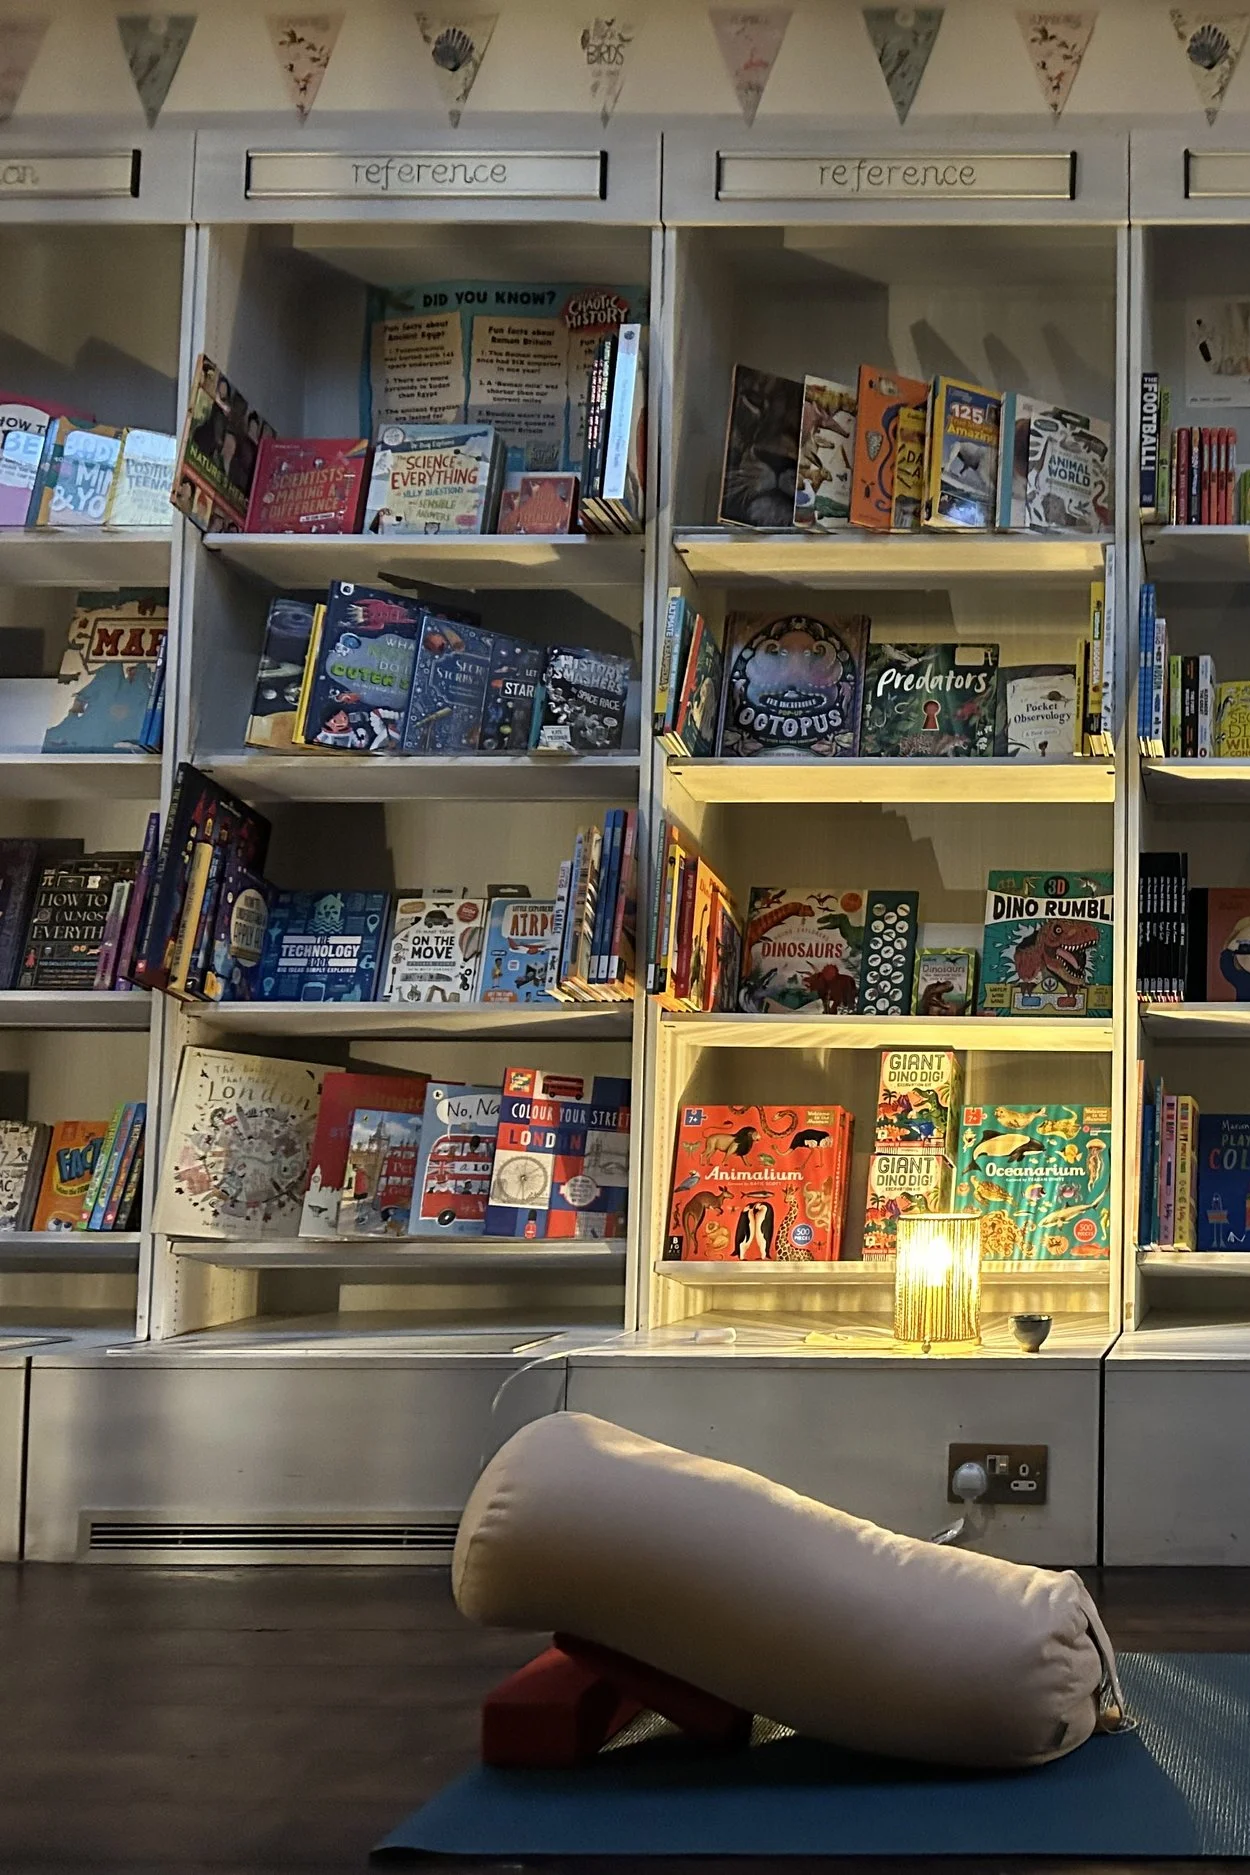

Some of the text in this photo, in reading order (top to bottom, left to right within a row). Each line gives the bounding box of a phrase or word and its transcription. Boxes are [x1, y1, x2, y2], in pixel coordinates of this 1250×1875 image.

[352, 158, 507, 190] reference
[818, 160, 977, 193] reference
[423, 290, 556, 307] DID YOU KNOW?
[567, 295, 617, 316] CHAOTIC
[564, 308, 628, 327] HISTORY
[951, 403, 983, 425] 125
[406, 453, 457, 471] SCIENCE
[1048, 454, 1092, 476] ANIMAL
[271, 465, 345, 490] SCIENTISTS
[391, 467, 479, 490] EVERYTHING
[1047, 465, 1092, 488] WORLD
[277, 485, 324, 503] MAKING
[260, 497, 341, 519] DIFFERENCE
[561, 654, 629, 675] HISTORY
[331, 664, 394, 688] OUTER
[553, 667, 623, 694] SMASHERS
[876, 663, 988, 698] Predators
[578, 689, 621, 711] SPACE RACE
[1025, 702, 1058, 712] Pocket
[740, 707, 843, 738] OCTOPUS
[1013, 710, 1072, 725] Observology
[1048, 880, 1067, 894] 3D
[40, 893, 108, 907] HOW TO
[993, 894, 1039, 920] DINO
[32, 925, 104, 940] EVERYTH
[509, 914, 555, 937] AIRP
[412, 935, 455, 946] ON THE
[281, 944, 360, 958] TECHNOLOGY
[411, 947, 453, 959] MOVE
[762, 942, 842, 959] DINOSAURS
[922, 964, 966, 974] Dinosaurs
[889, 1054, 946, 1071] GIANT
[888, 1070, 944, 1083] DINO DIG!
[209, 1081, 311, 1111] London
[447, 1098, 501, 1119] No, Na
[511, 1103, 632, 1128] COLOUR YOUR STREET
[688, 1115, 698, 1123] 7+
[1222, 1134, 1250, 1147] PLAY
[705, 1164, 804, 1181] Animalium
[876, 1157, 934, 1174] GIANT
[985, 1162, 1085, 1178] Oceanarium
[876, 1173, 933, 1187] DINO DIG!
[1078, 1224, 1094, 1232] 500
